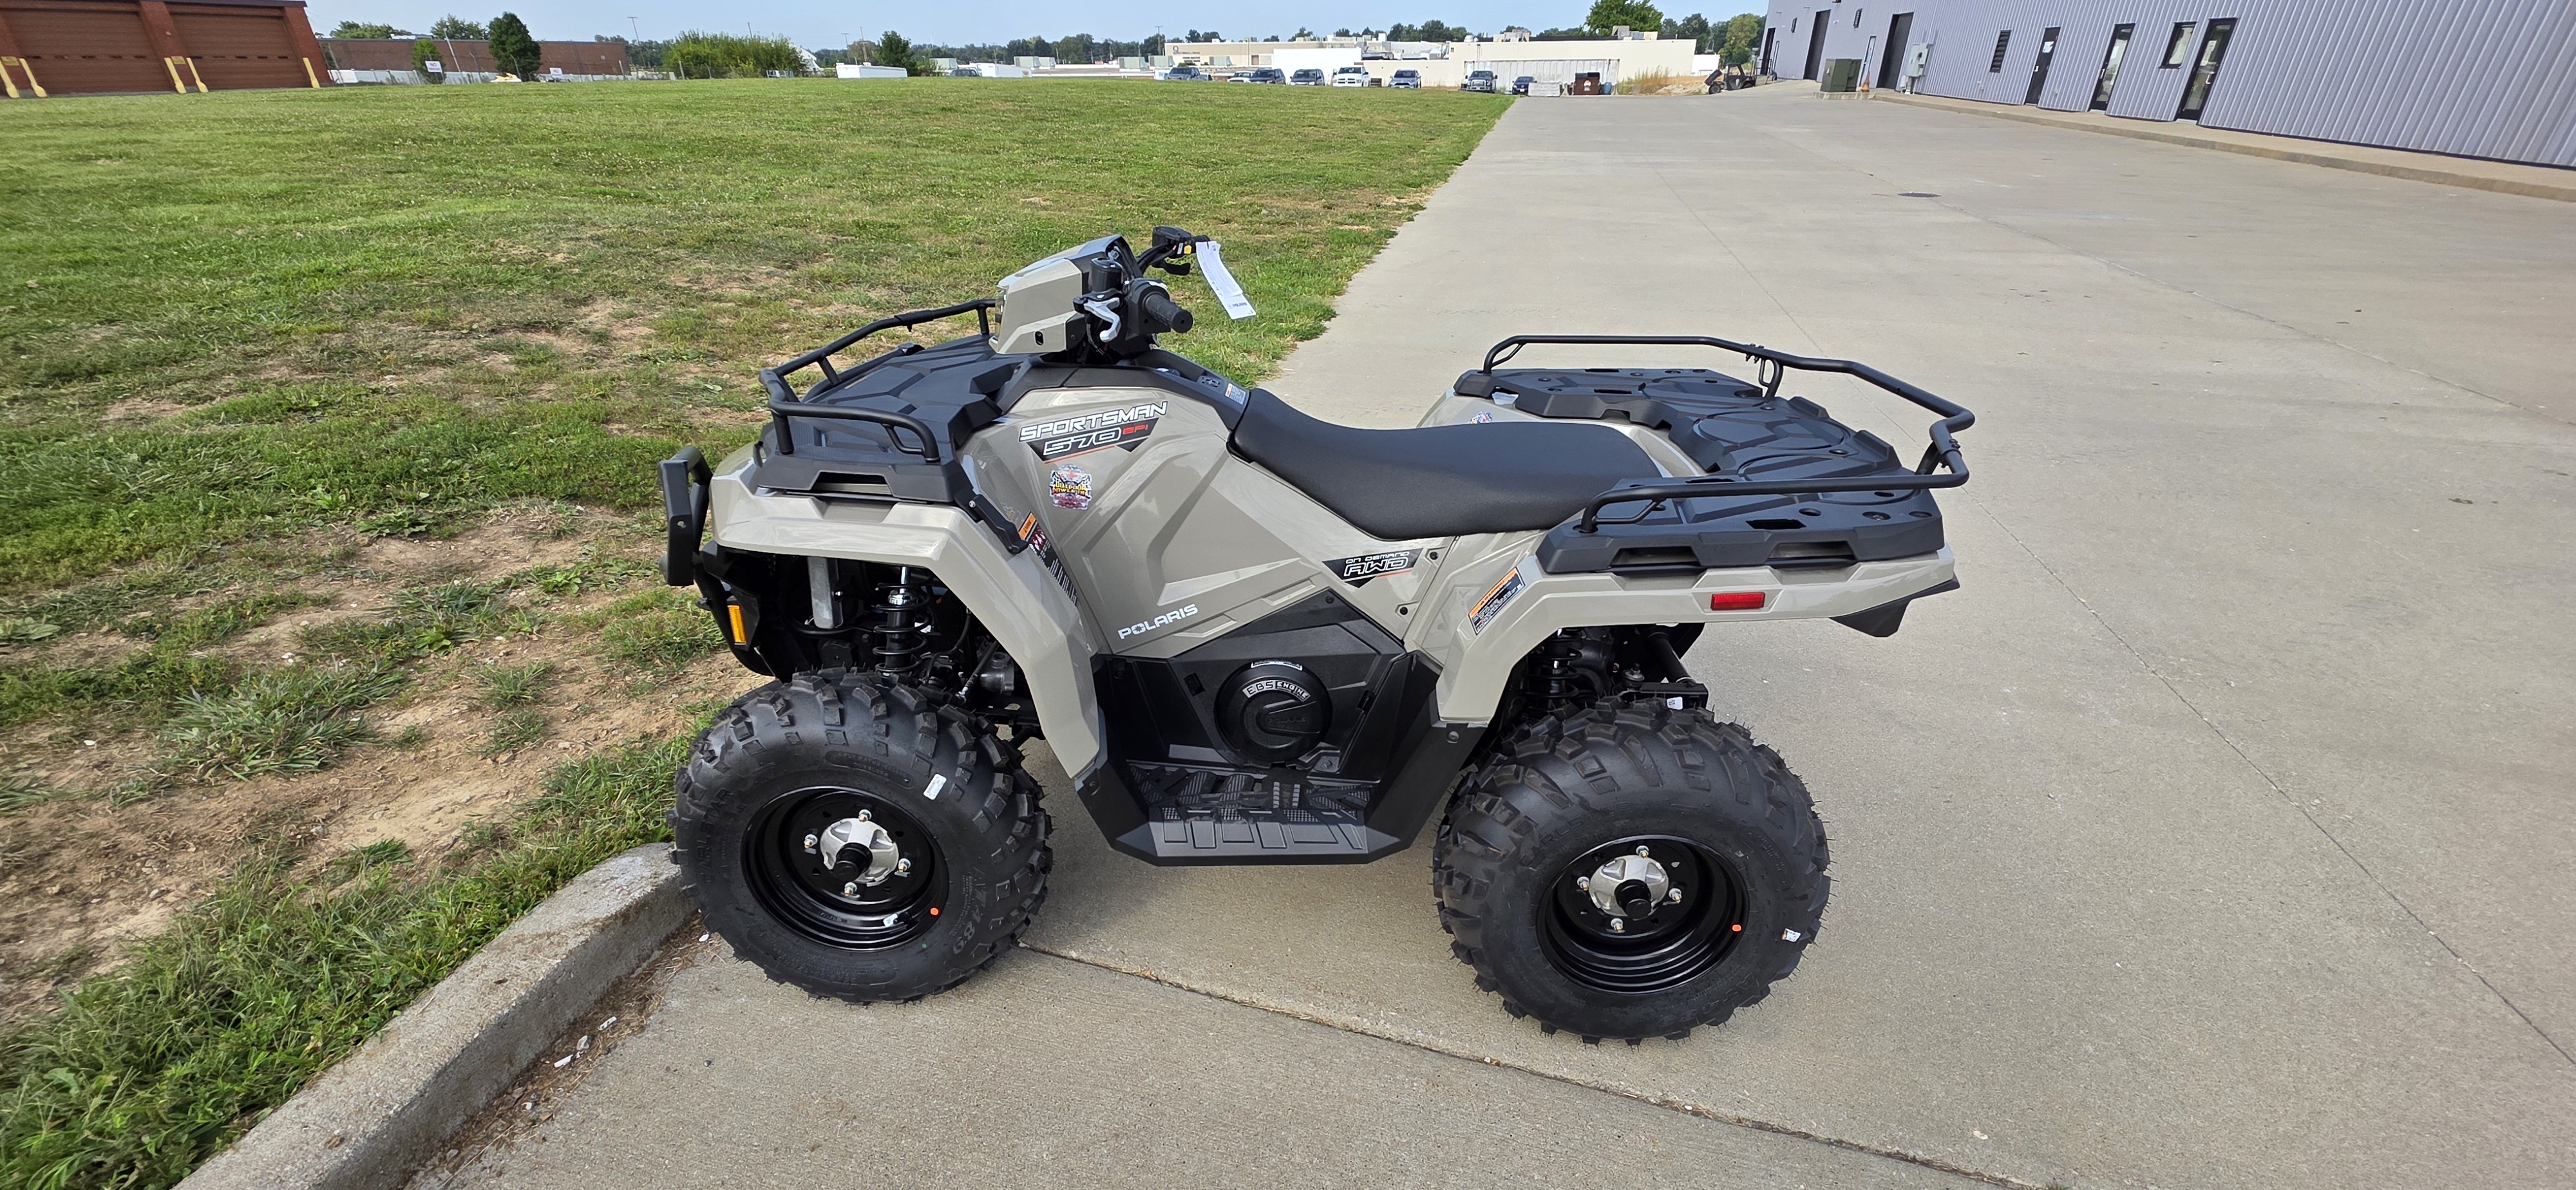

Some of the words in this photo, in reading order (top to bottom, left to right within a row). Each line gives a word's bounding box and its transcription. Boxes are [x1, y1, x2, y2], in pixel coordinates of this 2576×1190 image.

[1019, 401, 1168, 442] SPORTSMAN
[1043, 427, 1122, 456] 570
[1122, 424, 1148, 435] EFI
[1343, 556, 1409, 577] AWD
[1365, 551, 1410, 562] DEMAND
[1117, 603, 1198, 639] POLARIS
[1246, 681, 1274, 695] EBS
[1276, 681, 1309, 699] ENGINE
